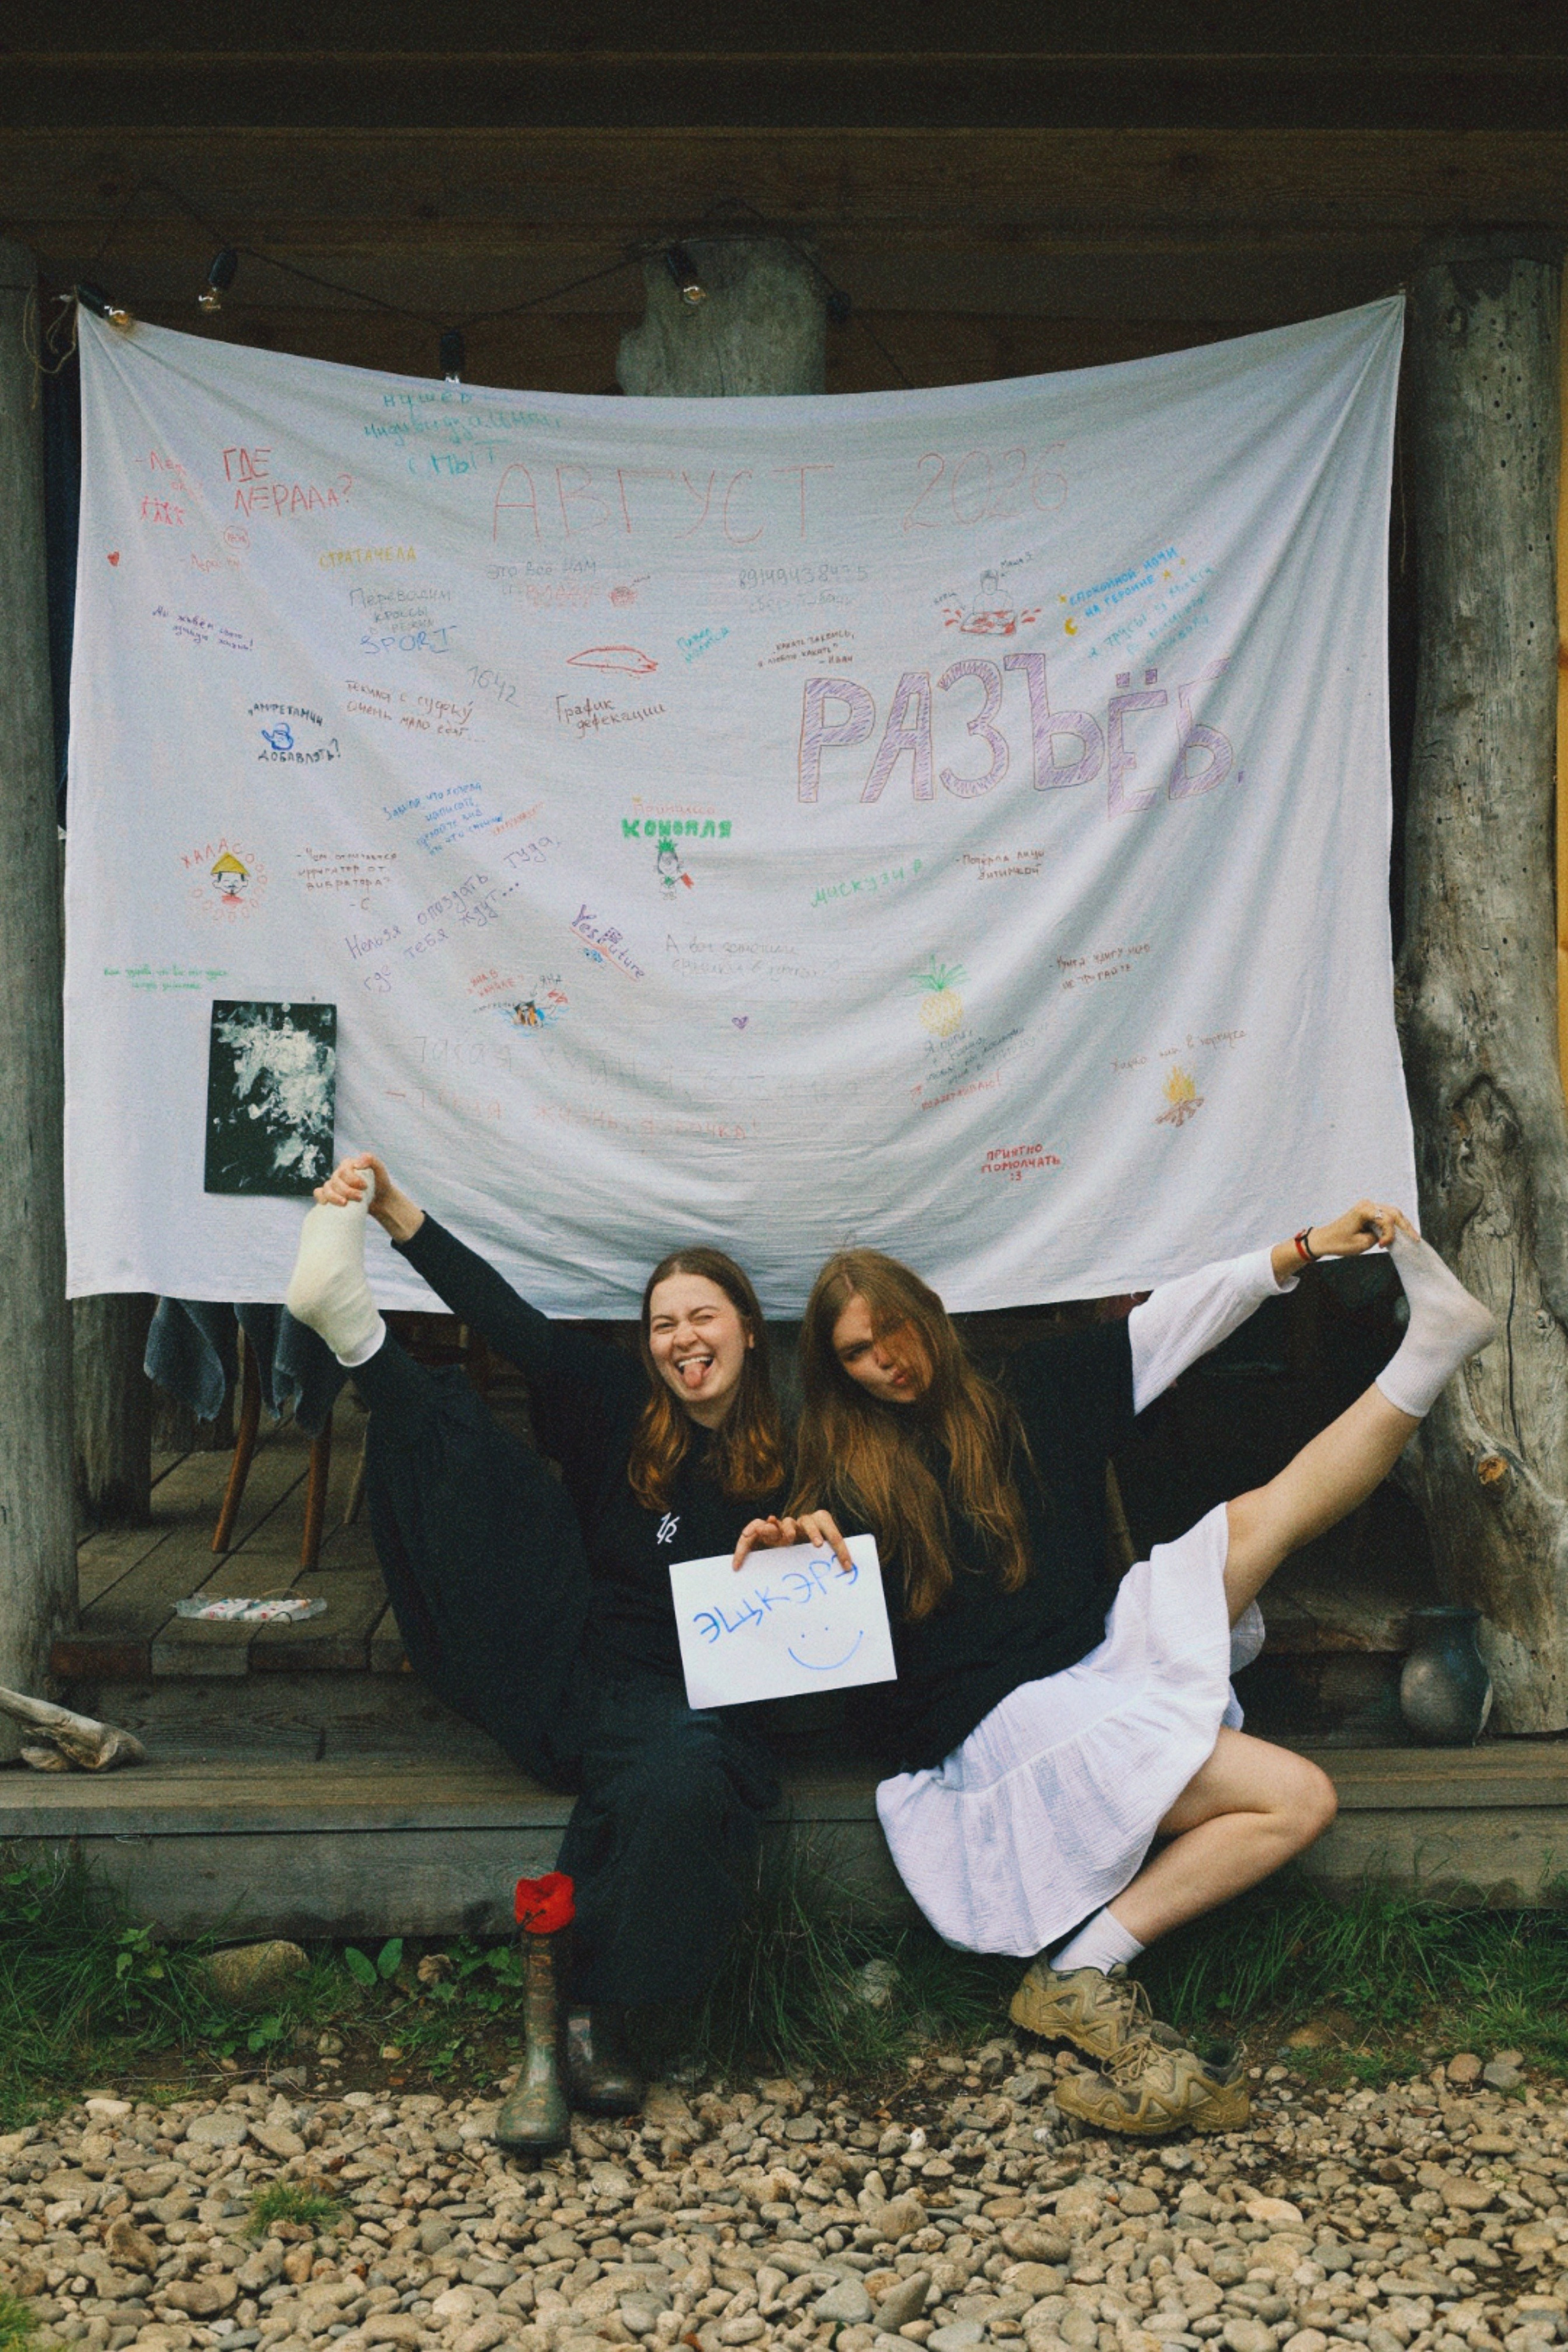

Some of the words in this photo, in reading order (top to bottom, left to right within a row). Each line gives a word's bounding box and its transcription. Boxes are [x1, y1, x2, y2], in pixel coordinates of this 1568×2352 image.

[222, 448, 273, 483] ГДЕ
[492, 464, 834, 545] АВГУСТ
[902, 442, 1068, 533] 2026
[360, 625, 458, 654] SPORT
[621, 818, 733, 838] КОНОПЛЯ
[981, 1155, 1061, 1174] ПОМОЛЧАТЬ
[986, 1144, 1043, 1161] ПРИЯТНО
